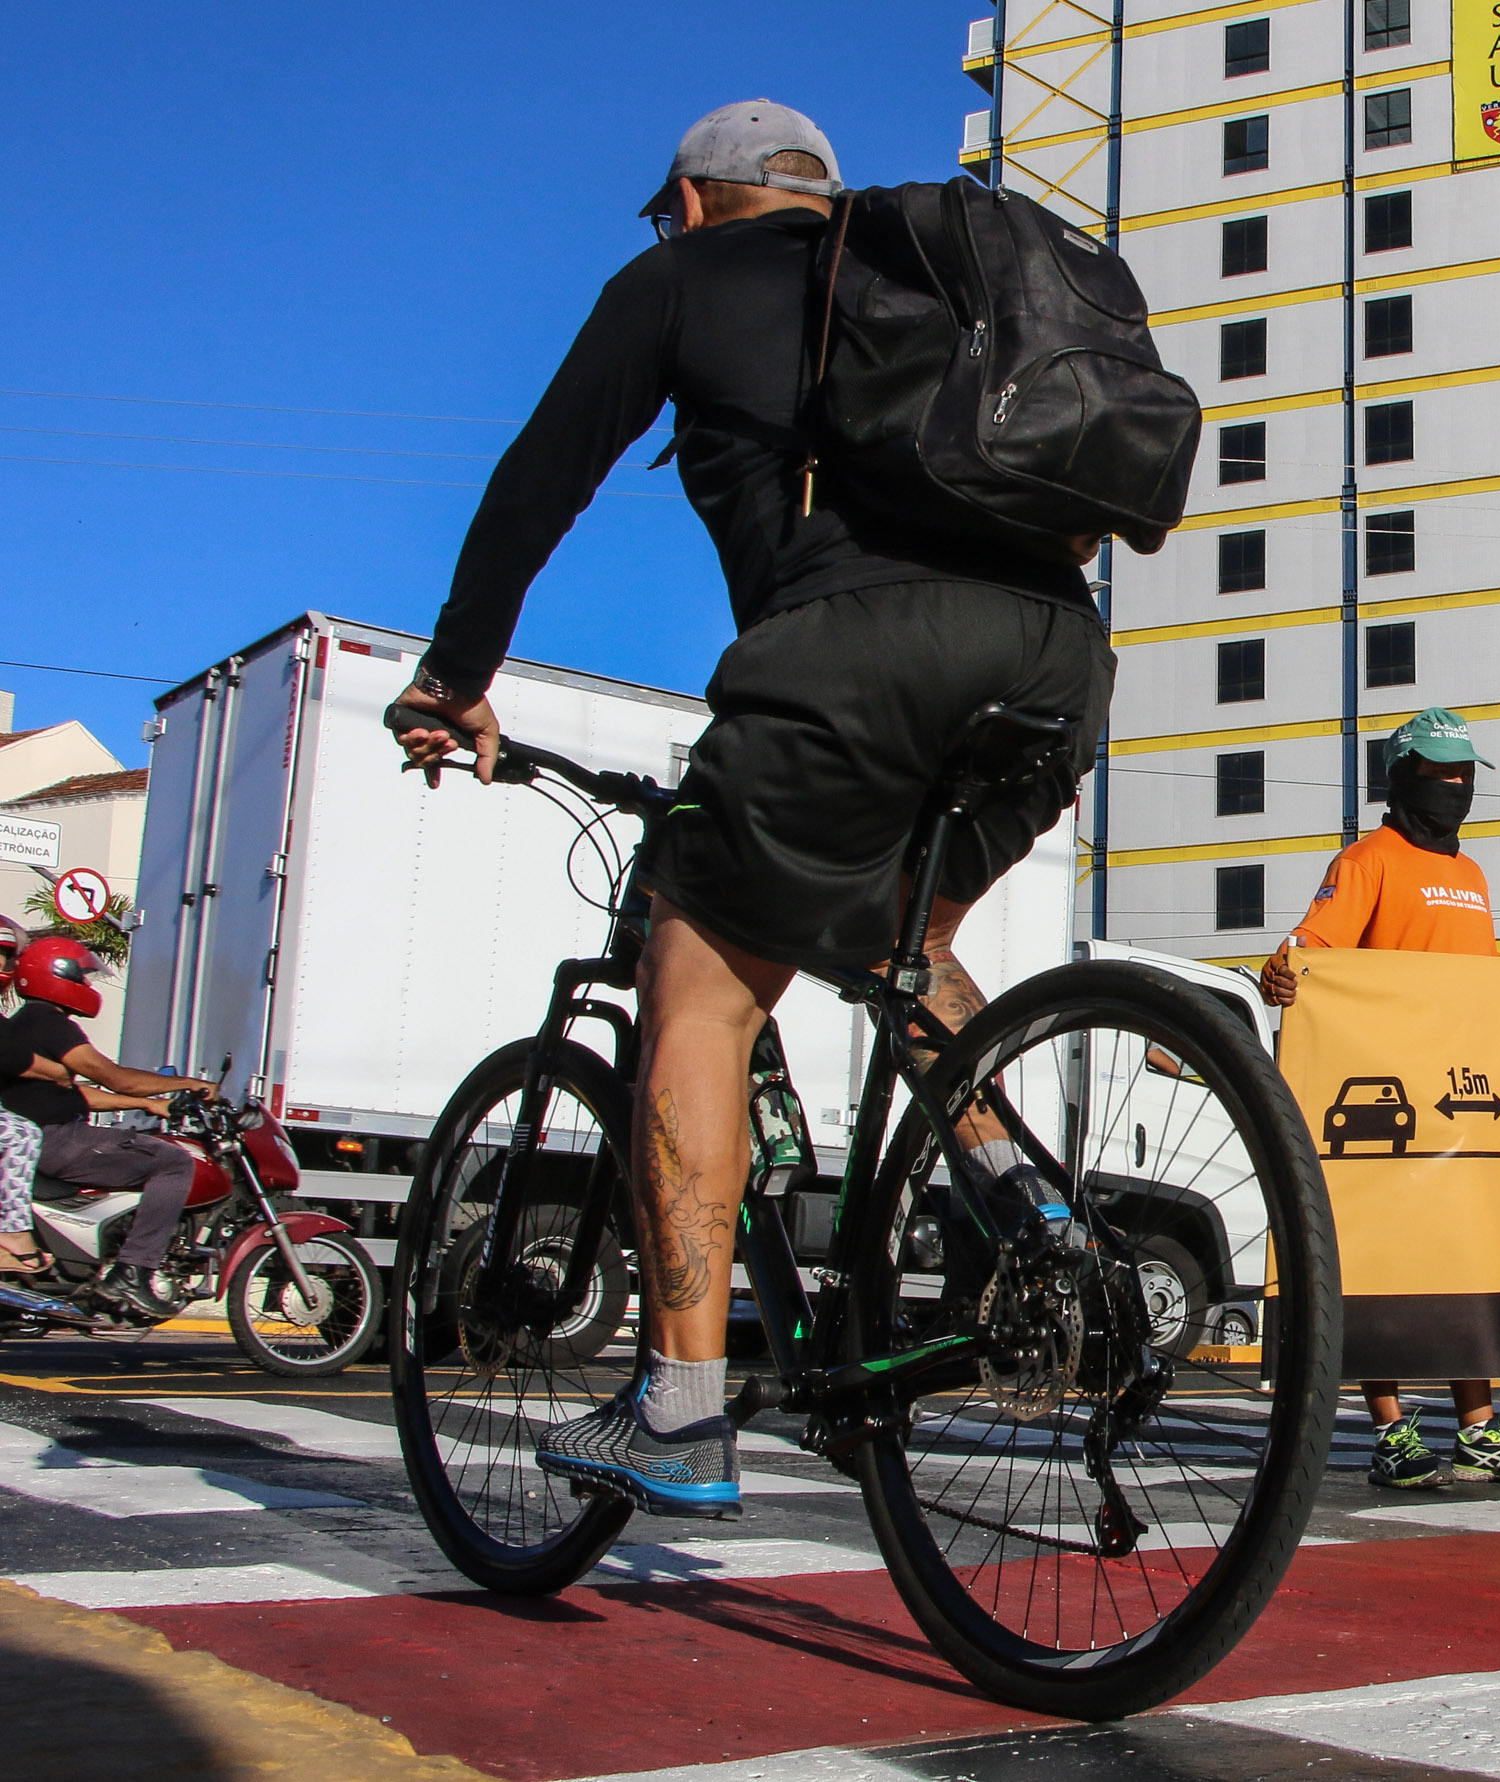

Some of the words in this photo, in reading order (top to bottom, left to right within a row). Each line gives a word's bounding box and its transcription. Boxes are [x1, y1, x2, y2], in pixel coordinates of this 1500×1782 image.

[1420, 886, 1448, 898] VIA
[1449, 888, 1486, 906] LIVRE
[1447, 1067, 1490, 1100] 1,5m
